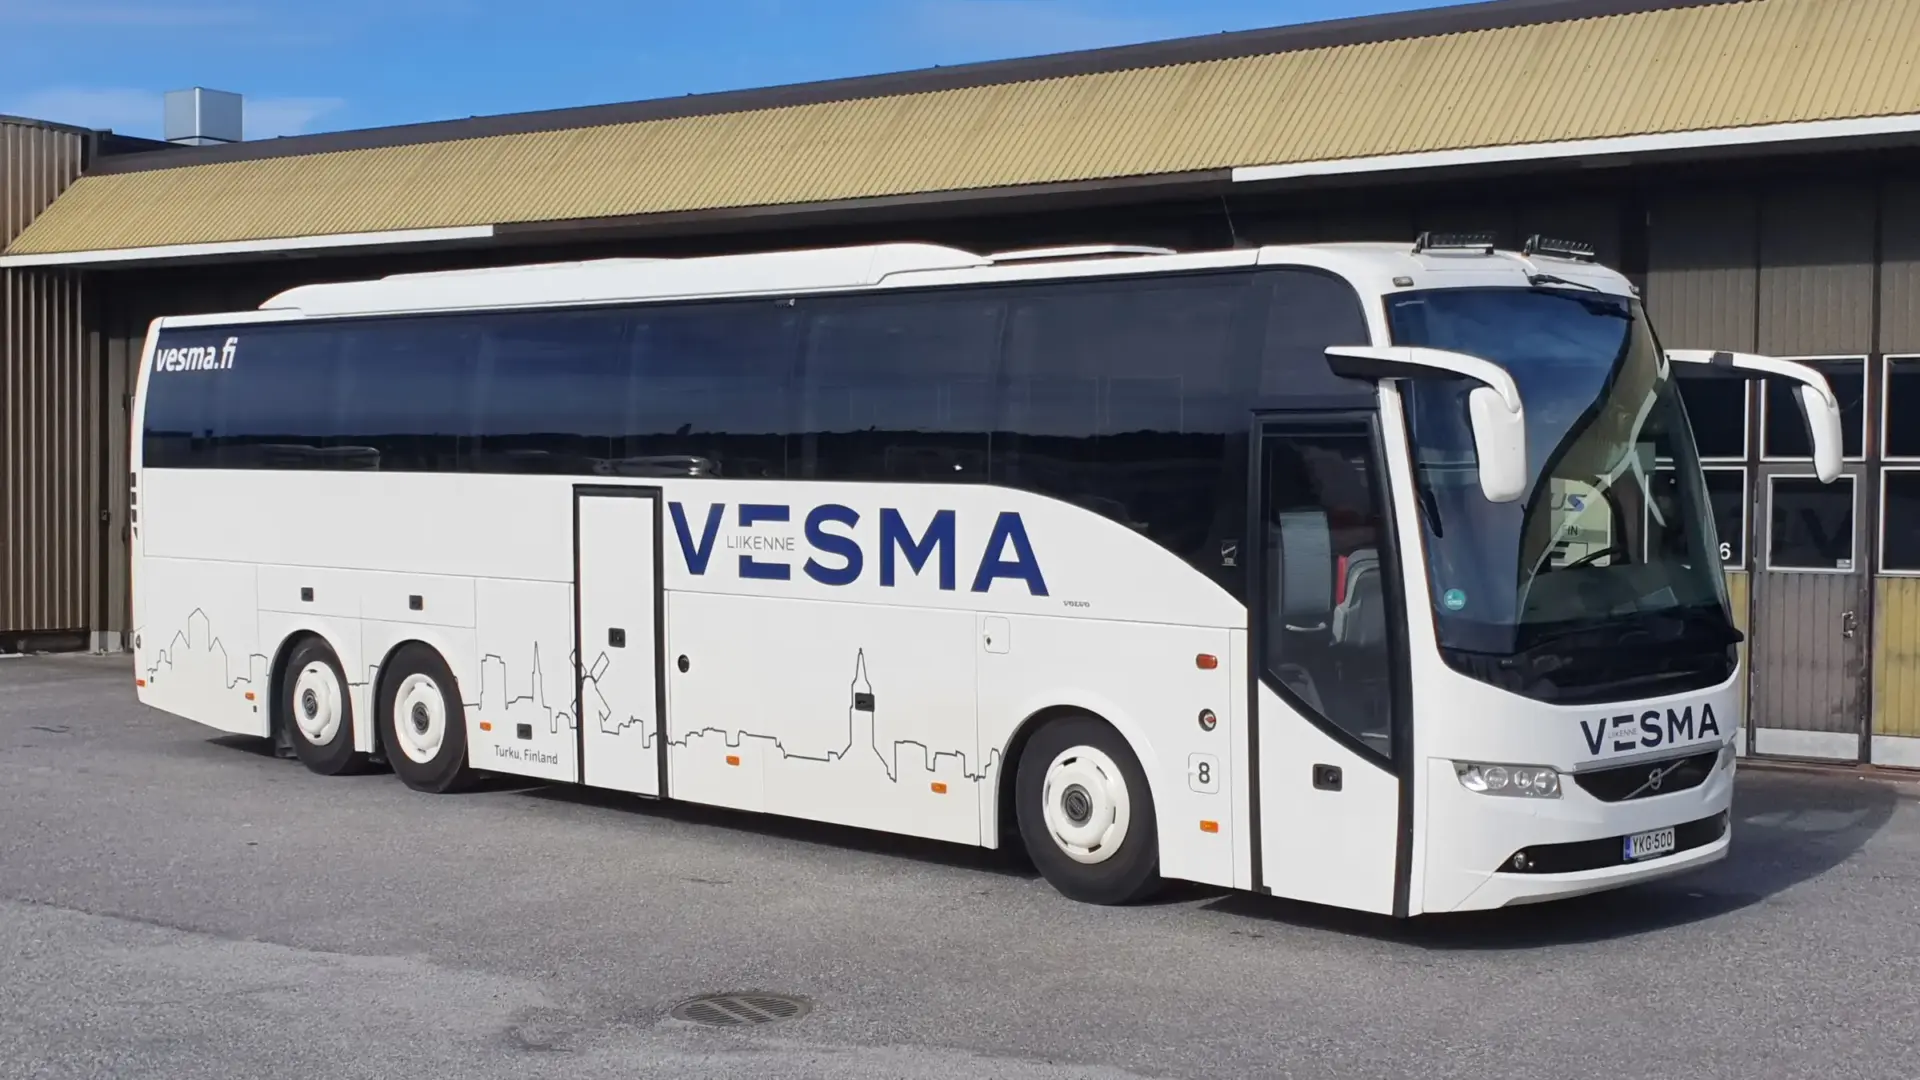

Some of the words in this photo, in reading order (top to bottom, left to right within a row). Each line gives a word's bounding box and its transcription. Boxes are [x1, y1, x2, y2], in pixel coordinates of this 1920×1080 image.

[155, 336, 238, 372] vesma.fi
[668, 501, 1049, 597] VESMA
[726, 534, 795, 552] LIIKENNE
[1063, 600, 1090, 608] VOLVO
[1580, 703, 1720, 756] VESMA
[494, 744, 522, 760] Turku,
[523, 748, 558, 765] Finland
[1198, 761, 1211, 784] 8
[1632, 831, 1673, 855] YKG-500
